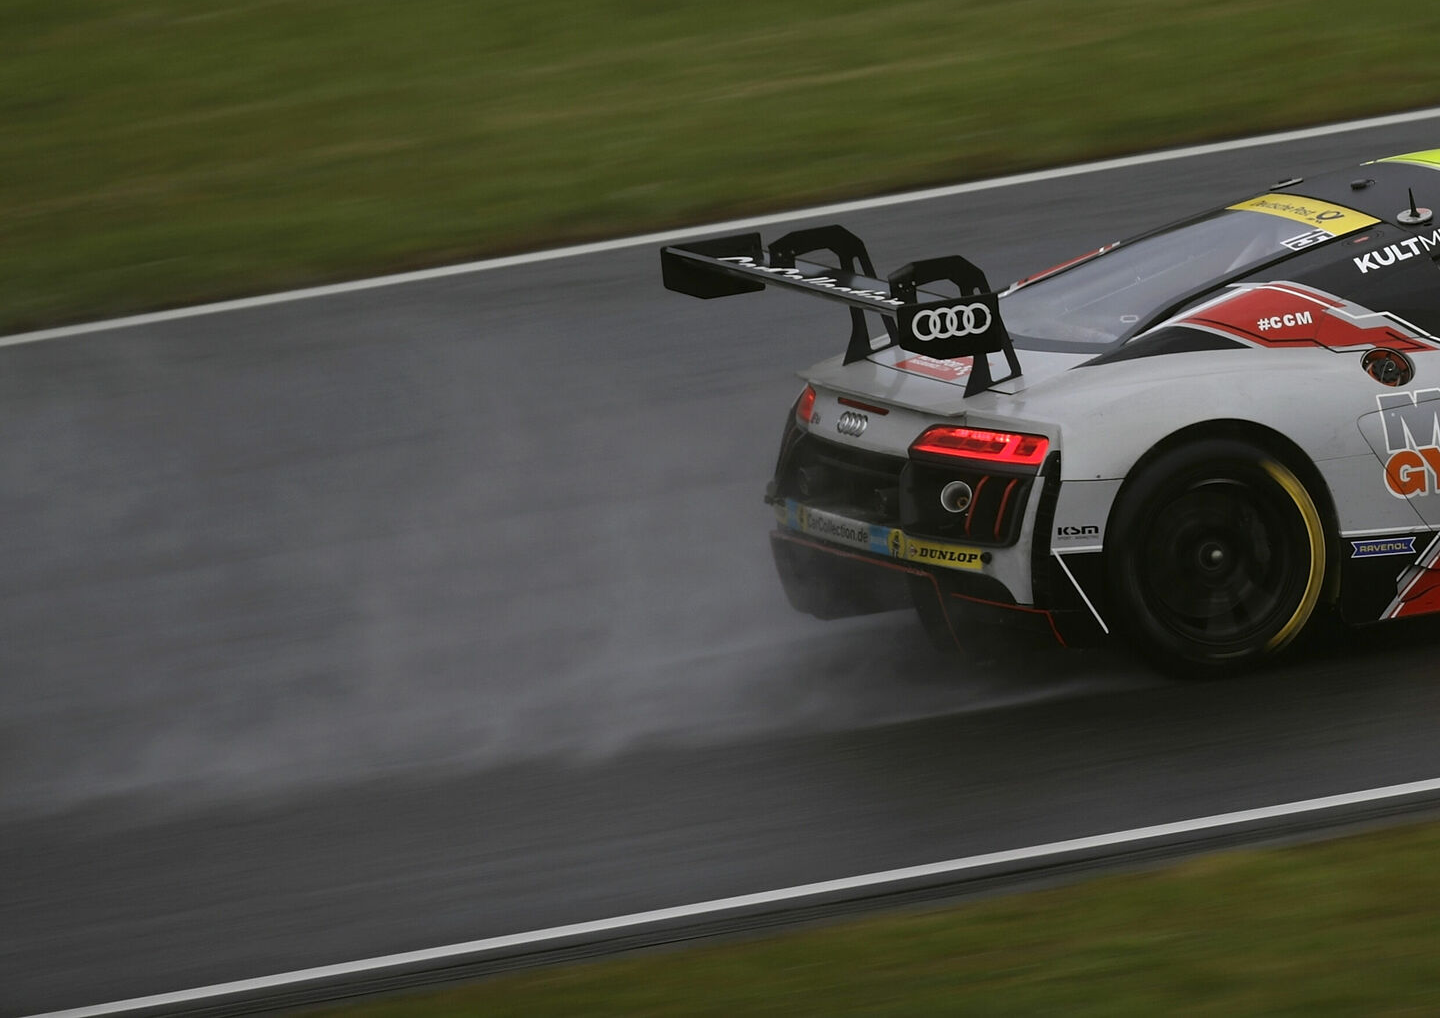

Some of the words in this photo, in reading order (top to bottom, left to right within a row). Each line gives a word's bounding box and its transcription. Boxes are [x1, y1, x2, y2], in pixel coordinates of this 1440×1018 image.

[1257, 311, 1313, 331] #CCM
[1058, 526, 1099, 536] KSM
[1359, 543, 1408, 553] RAVENOL
[919, 547, 978, 564] DUNLOP
